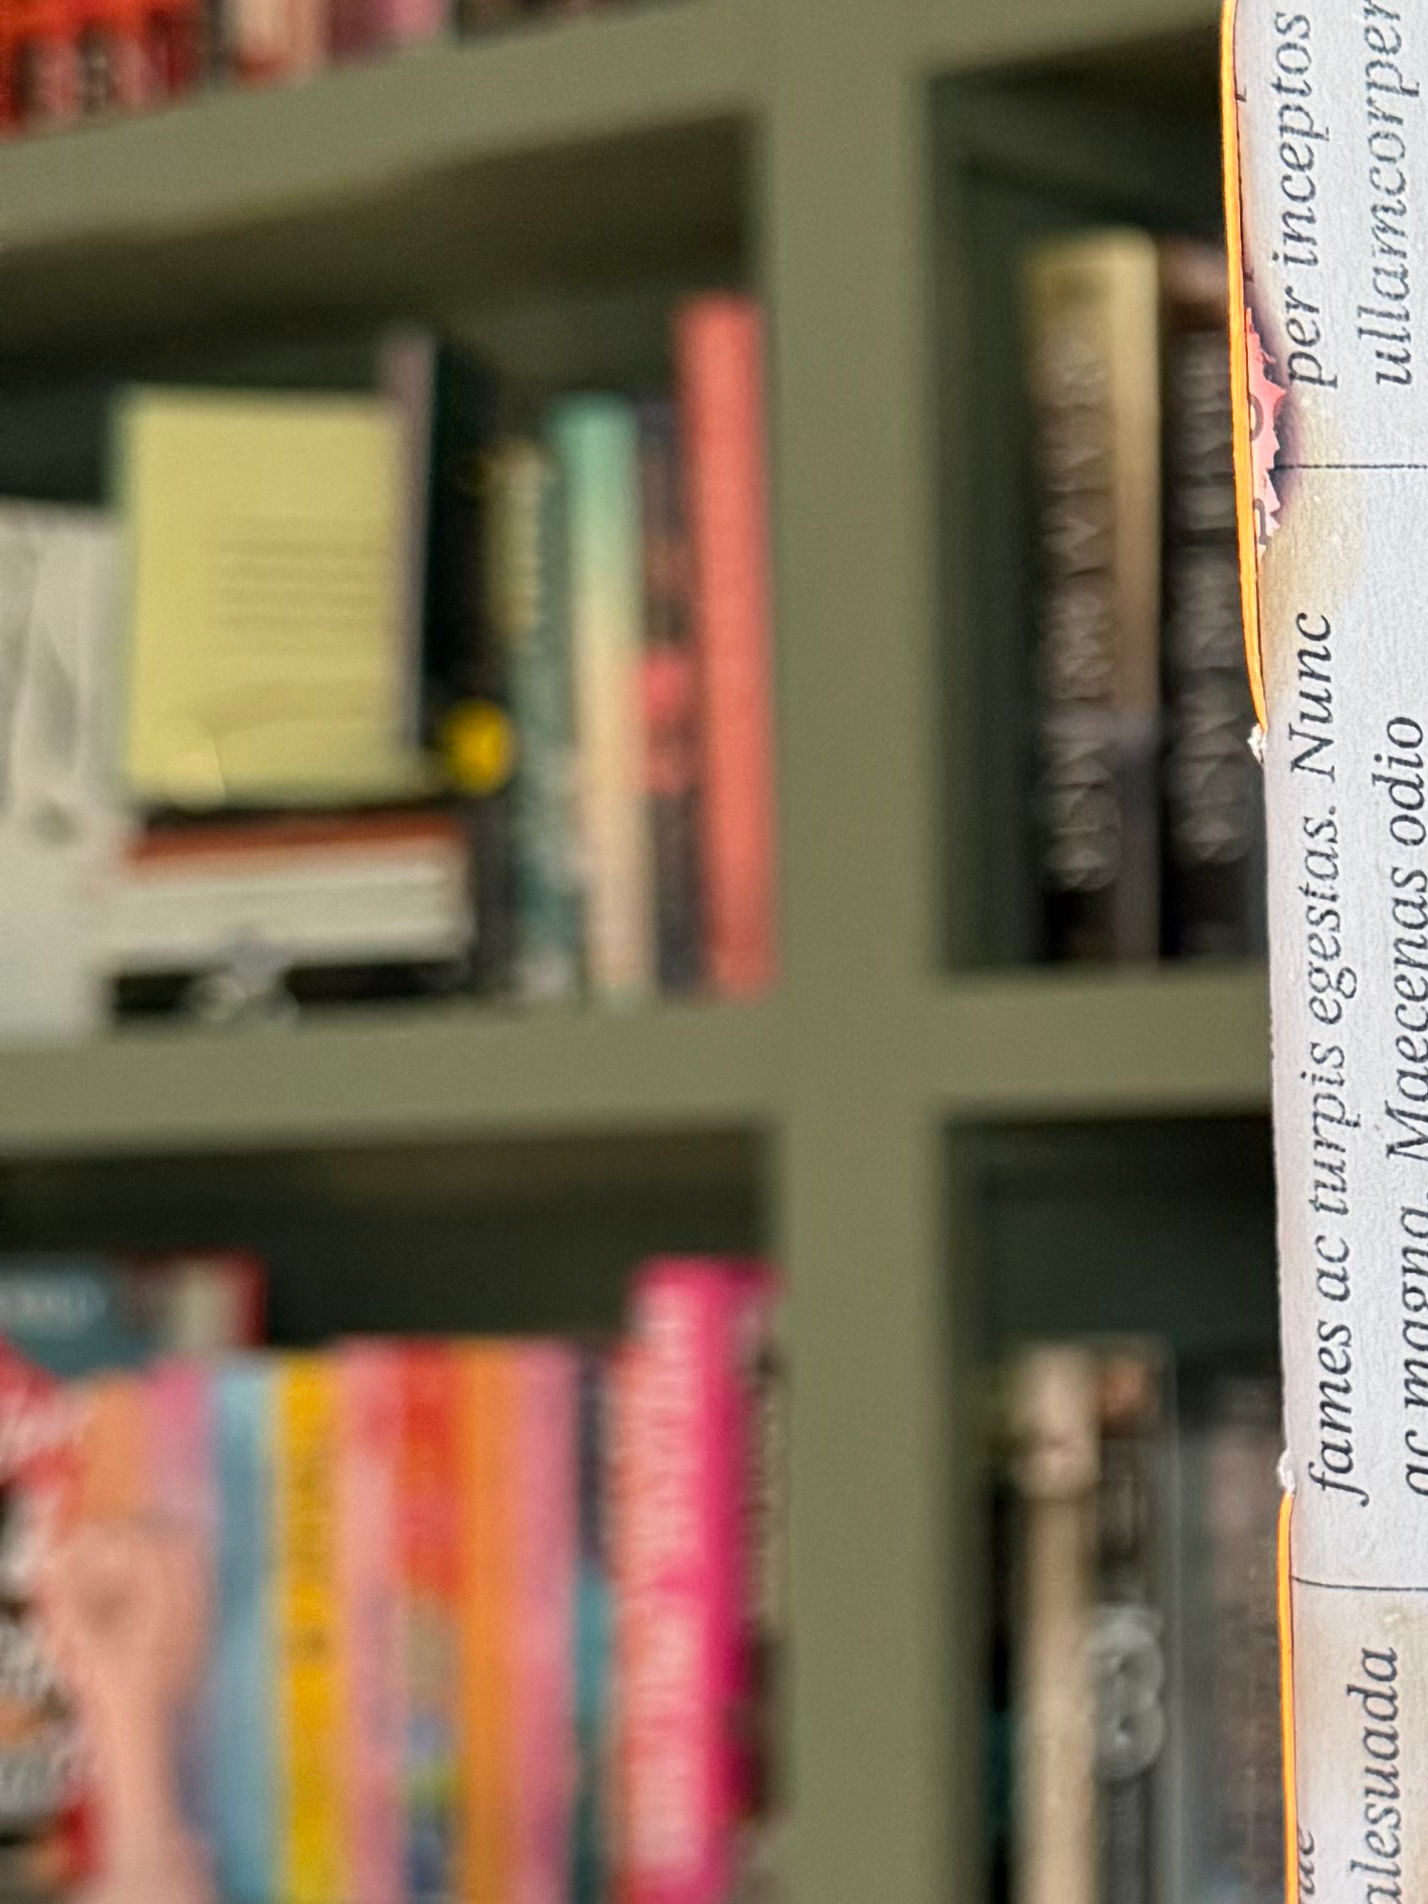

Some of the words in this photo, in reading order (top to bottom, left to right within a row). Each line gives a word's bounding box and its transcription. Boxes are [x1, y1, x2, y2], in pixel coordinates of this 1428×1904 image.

[1263, 9, 1330, 268] inceptos
[1284, 287, 1338, 390] per
[1290, 611, 1338, 780] Nunc
[1371, 714, 1426, 847] odio
[1300, 803, 1358, 1027] egestas.
[1301, 1040, 1362, 1216] turpis
[1314, 1234, 1352, 1303] ac
[1309, 1320, 1369, 1507] fames
